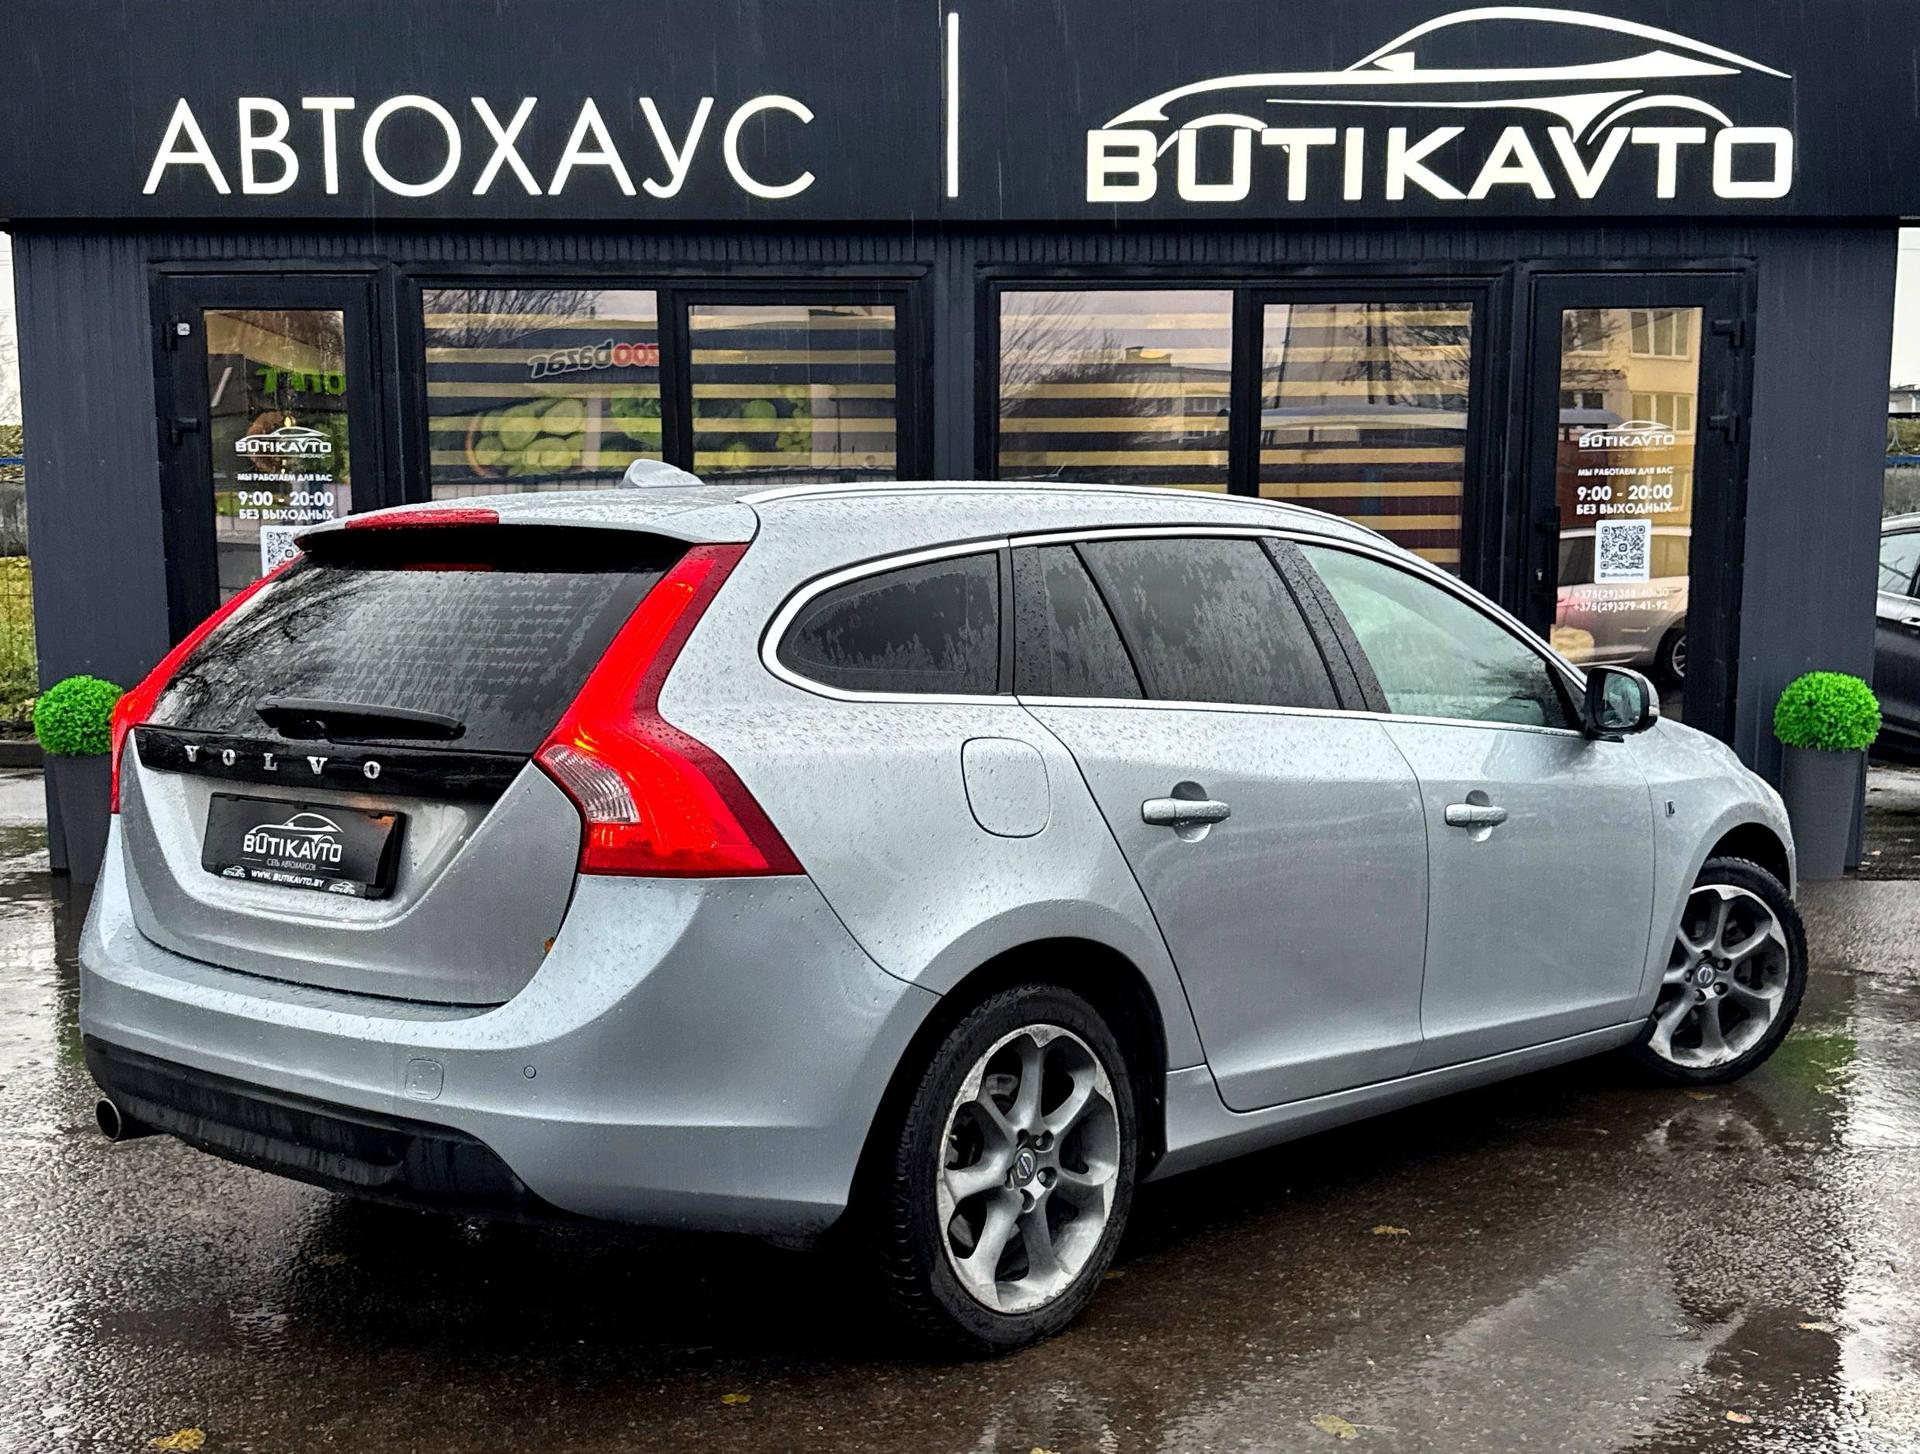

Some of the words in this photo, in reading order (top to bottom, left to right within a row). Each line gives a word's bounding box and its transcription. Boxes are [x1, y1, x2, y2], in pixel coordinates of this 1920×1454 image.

[142, 94, 816, 199] АВТОХАУС
[1086, 126, 1794, 203] BUTIKAVTO
[235, 441, 332, 453] BUTIKAVTO
[1578, 434, 1676, 448] BUTIKAVTO
[237, 473, 252, 481] МЫ
[253, 473, 296, 481] РАБОТАЕМ
[297, 473, 314, 482] ДЛЯ
[315, 473, 333, 481] ВАС
[1577, 468, 1593, 477] МЫ
[1594, 467, 1637, 476] РАБОТАЕМ
[1638, 466, 1655, 476] ДЛЯ
[1656, 466, 1675, 475] ВАС
[238, 491, 274, 506] 9:00
[289, 491, 335, 507] 20:00
[1577, 485, 1612, 501] 9:00
[1627, 484, 1674, 500] 20:00
[239, 509, 260, 520] БЕЗ
[262, 509, 335, 521] ВЫХОДНЫХ
[1576, 503, 1597, 515] БЕЗ
[1600, 501, 1673, 515] ВЫХОДНЫХ
[1573, 600, 1668, 613] +375(29)379-41-92
[185, 744, 381, 780] VOLVO
[243, 834, 342, 863] BUTIKAVTO
[273, 872, 324, 888] BUTIKAVTO.BY
